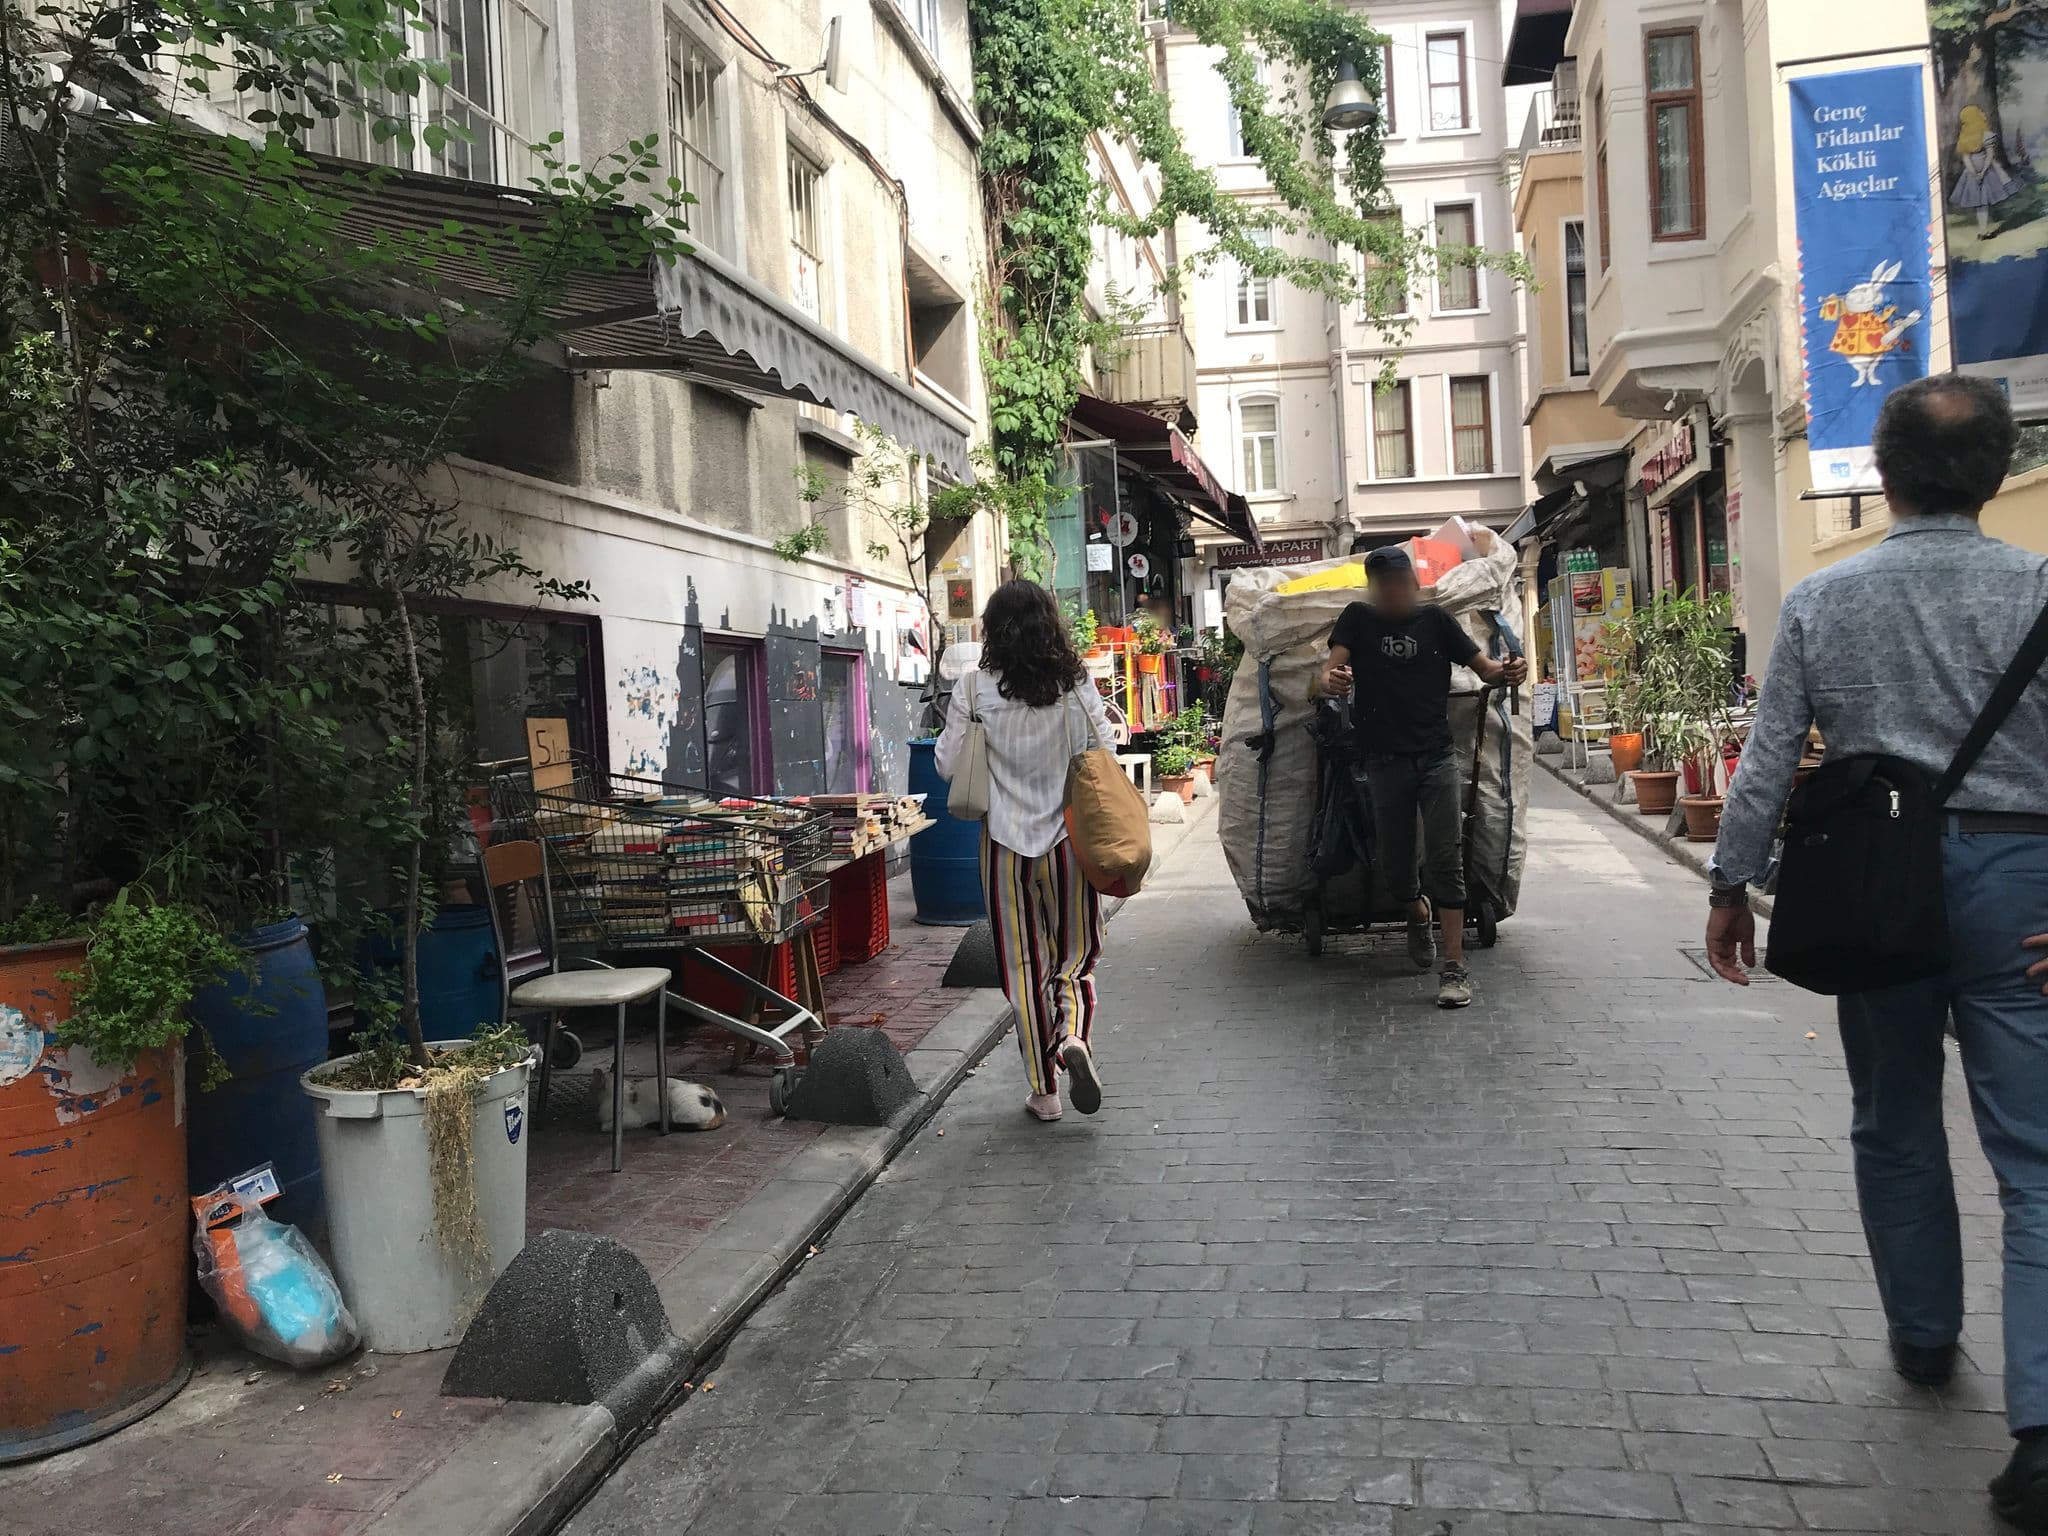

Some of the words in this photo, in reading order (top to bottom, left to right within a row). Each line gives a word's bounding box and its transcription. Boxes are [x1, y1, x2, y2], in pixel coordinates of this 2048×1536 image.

[1813, 105, 1867, 123] Genç
[1815, 123, 1904, 149] Fidanlar
[1816, 150, 1877, 174] Köklü
[1817, 174, 1899, 201] Ağaçlar
[1271, 540, 1319, 553] APART
[1381, 635, 1417, 656] HOT
[536, 730, 550, 765] 5
